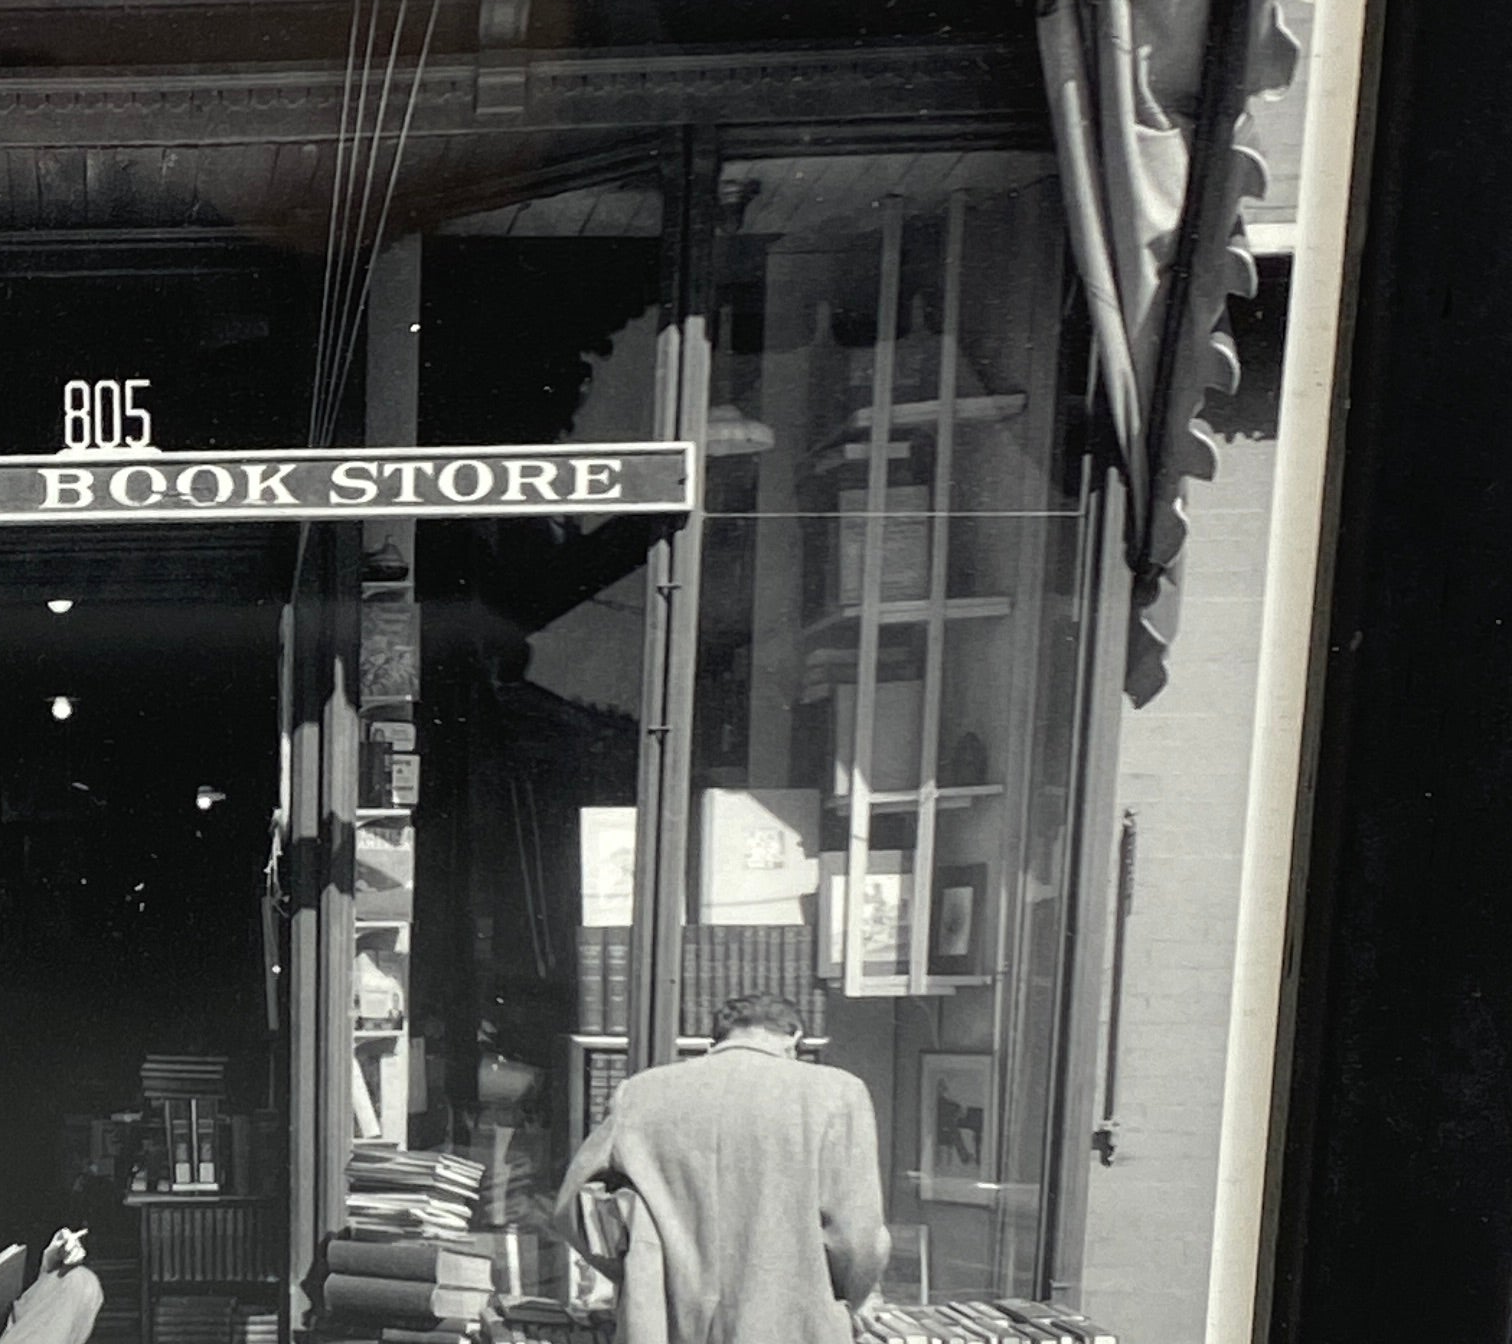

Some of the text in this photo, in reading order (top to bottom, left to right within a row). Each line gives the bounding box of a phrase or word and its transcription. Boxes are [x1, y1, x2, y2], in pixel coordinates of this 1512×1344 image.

[64, 378, 151, 449] 805
[36, 464, 302, 510] BOOK
[328, 458, 624, 506] STORE
